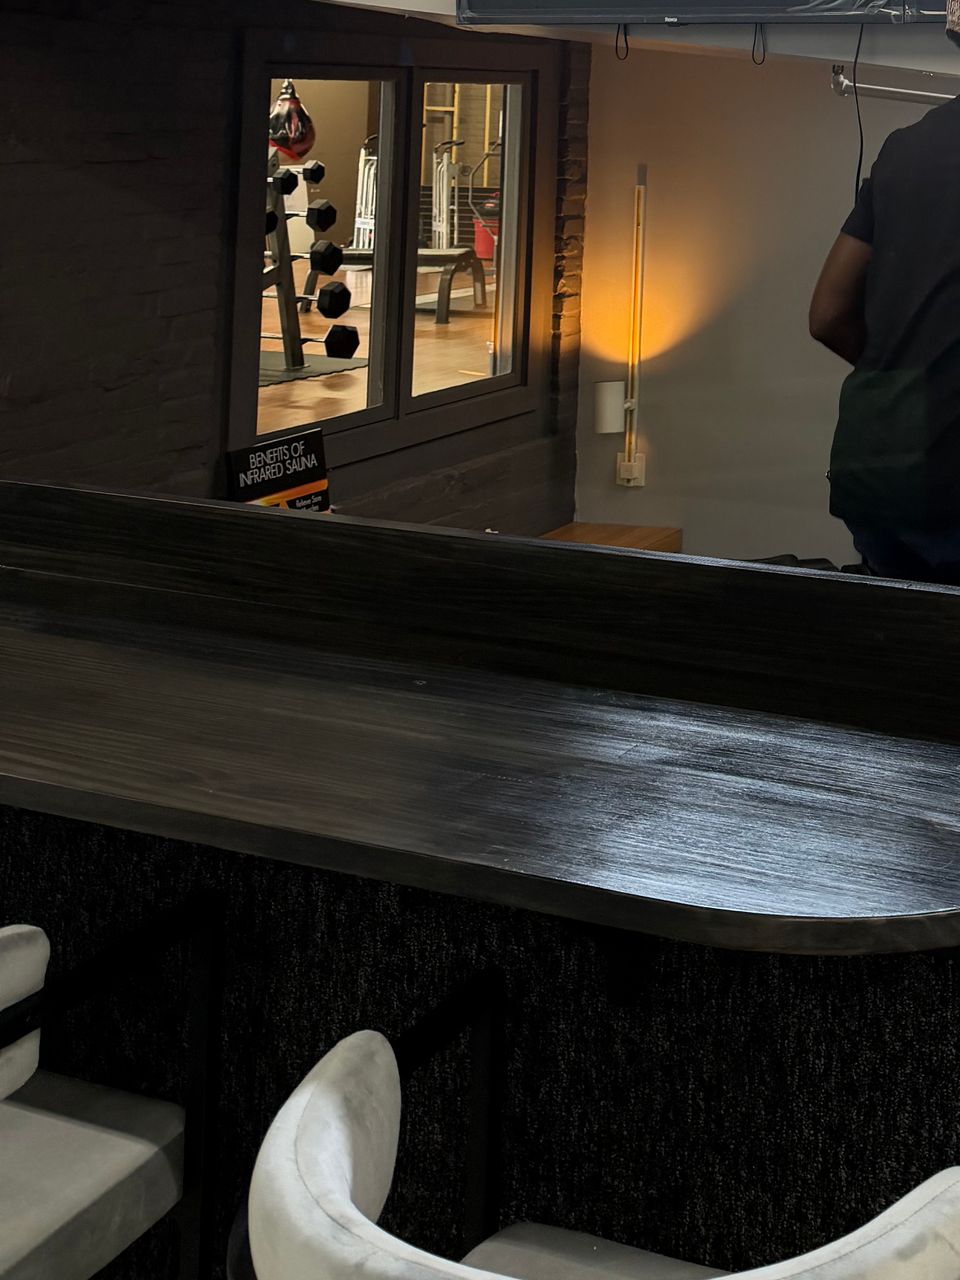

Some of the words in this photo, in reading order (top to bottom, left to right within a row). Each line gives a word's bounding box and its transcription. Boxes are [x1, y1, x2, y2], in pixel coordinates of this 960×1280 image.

[239, 462, 284, 488] INFRARED
[286, 453, 319, 475] SAUNA
[249, 445, 290, 469] BENEFITS
[291, 440, 305, 457] OF
